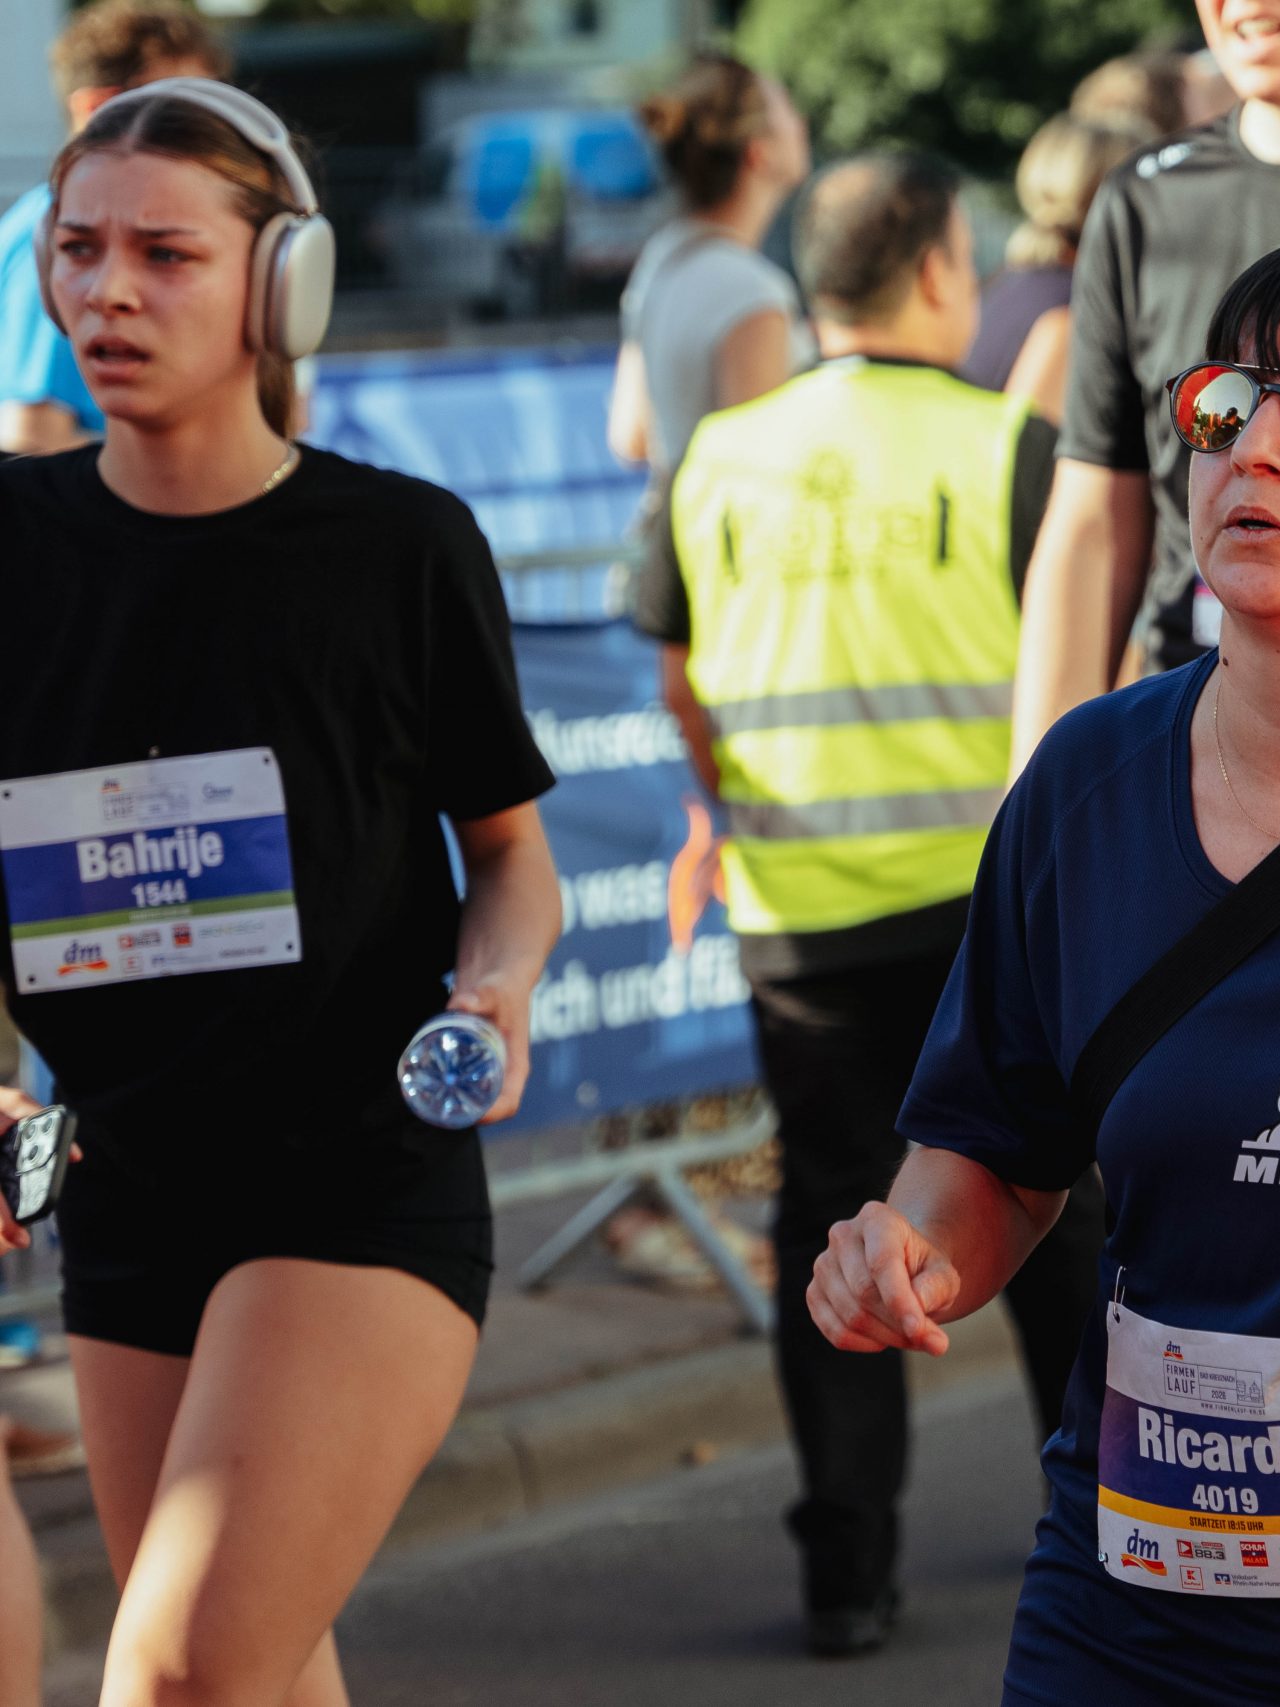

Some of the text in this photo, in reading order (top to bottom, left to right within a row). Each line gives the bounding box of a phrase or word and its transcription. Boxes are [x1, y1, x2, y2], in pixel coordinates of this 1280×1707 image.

[77, 826, 223, 883] Bahrije
[131, 879, 187, 907] 1544
[64, 939, 101, 964] dm
[602, 947, 689, 1028] und
[1166, 1340, 1181, 1353] dm
[1166, 1363, 1195, 1379] FIRMEN
[1199, 1371, 1209, 1380] BAD
[1167, 1377, 1196, 1394] LAUF
[1192, 1484, 1259, 1514] 4019
[1189, 1516, 1264, 1531] STARTZEIT 18:15 UHR
[1126, 1528, 1159, 1560] dm
[1240, 1543, 1266, 1551] SCHUH
[1194, 1549, 1228, 1560] 88.3
